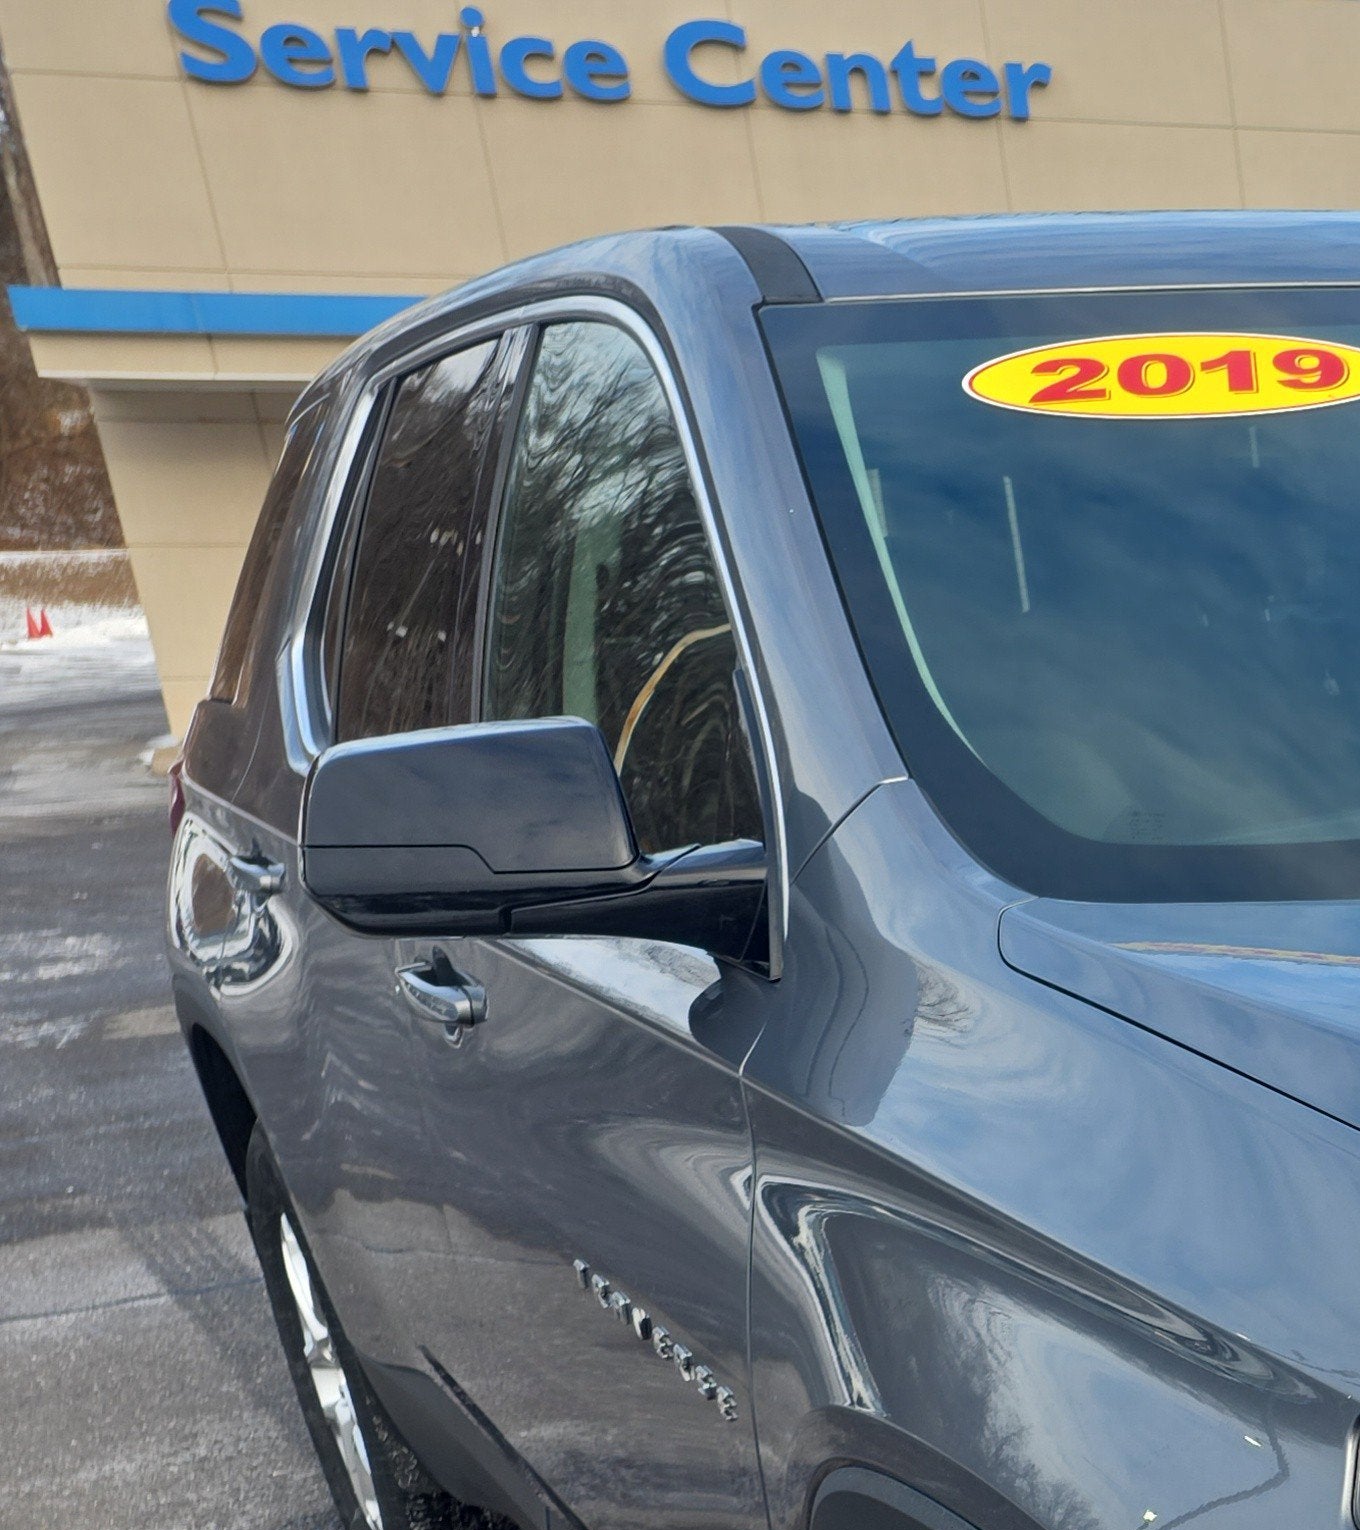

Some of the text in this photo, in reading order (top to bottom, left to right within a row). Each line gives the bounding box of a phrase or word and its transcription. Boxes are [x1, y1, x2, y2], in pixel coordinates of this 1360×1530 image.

[167, 0, 1052, 120] Service Center
[1028, 348, 1349, 405] 2019
